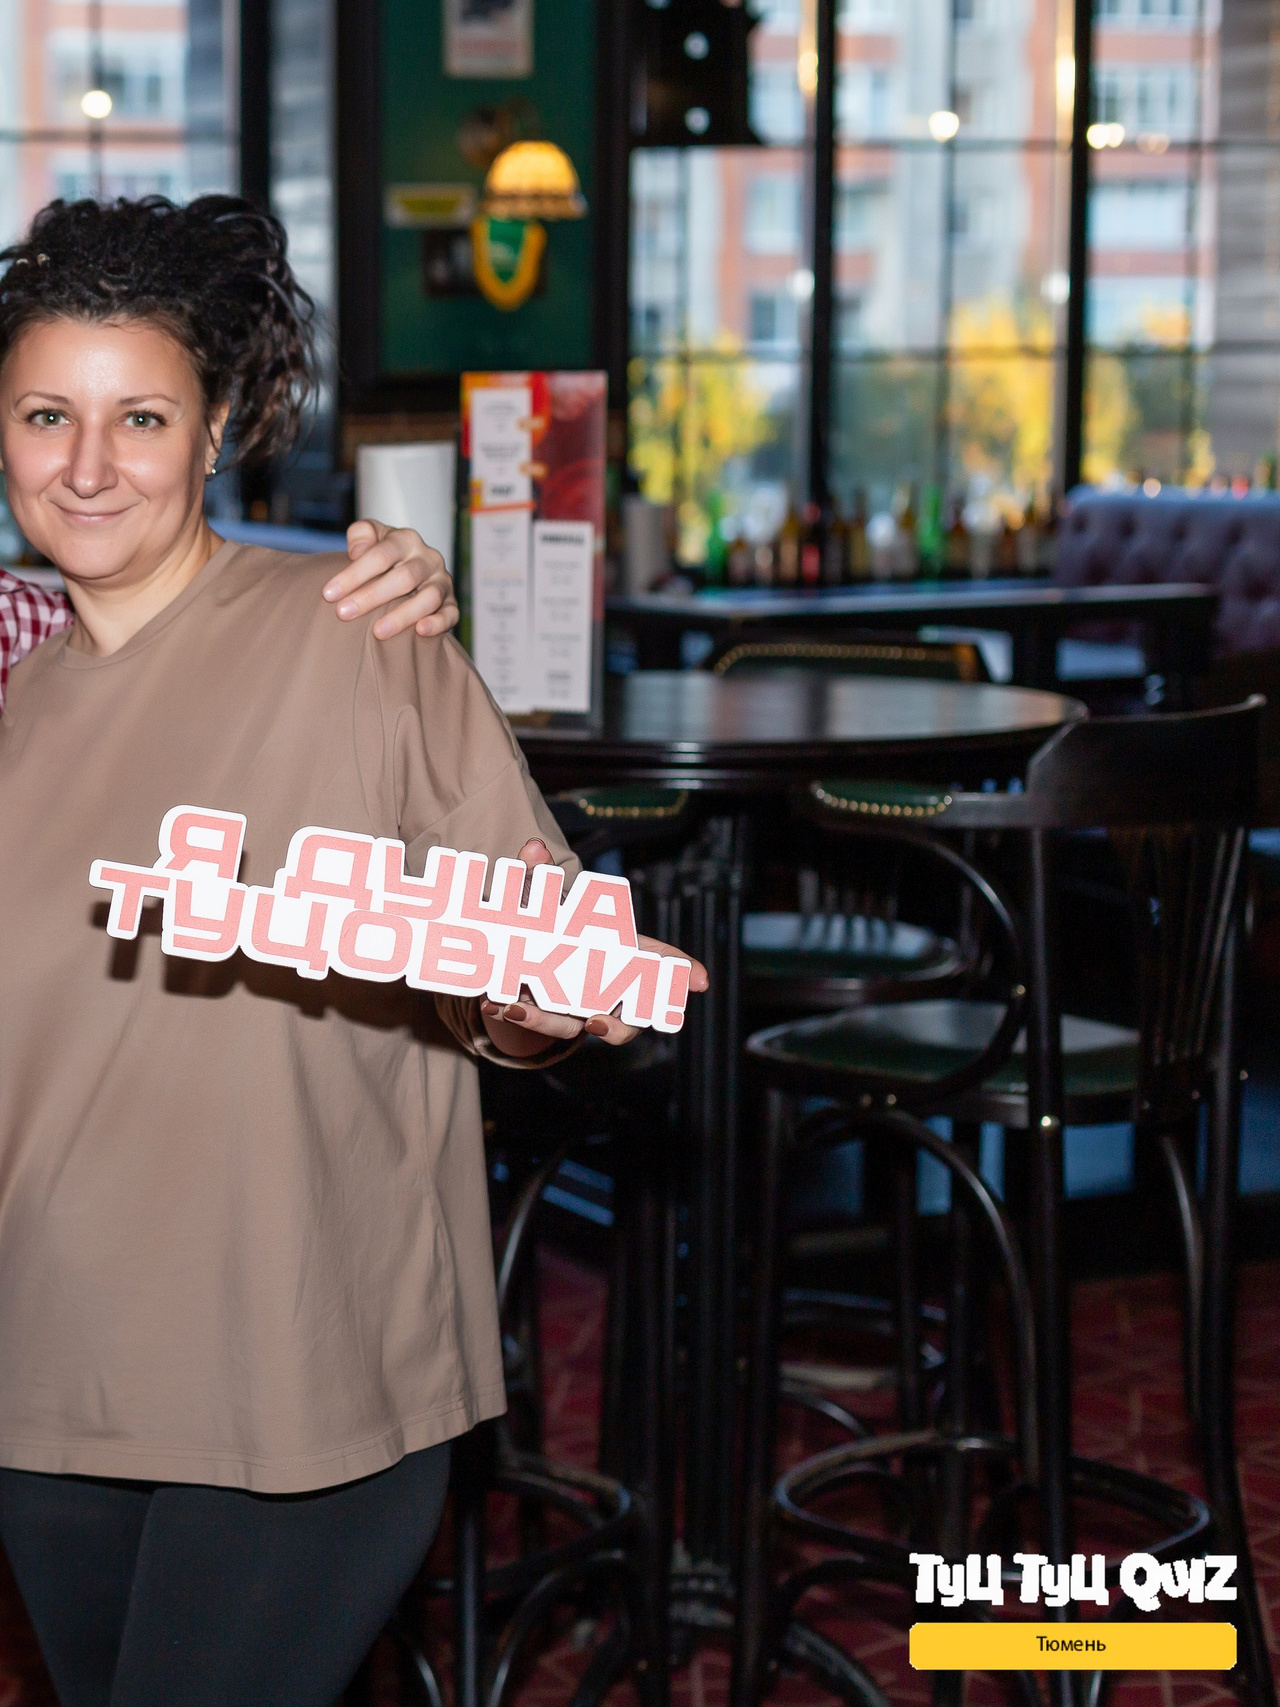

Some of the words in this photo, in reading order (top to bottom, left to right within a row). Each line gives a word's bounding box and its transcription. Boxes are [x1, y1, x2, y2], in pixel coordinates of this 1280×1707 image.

[99, 867, 691, 1026] ТУЦОВКИ!
[166, 813, 246, 879] Я
[284, 833, 637, 948] ДУША
